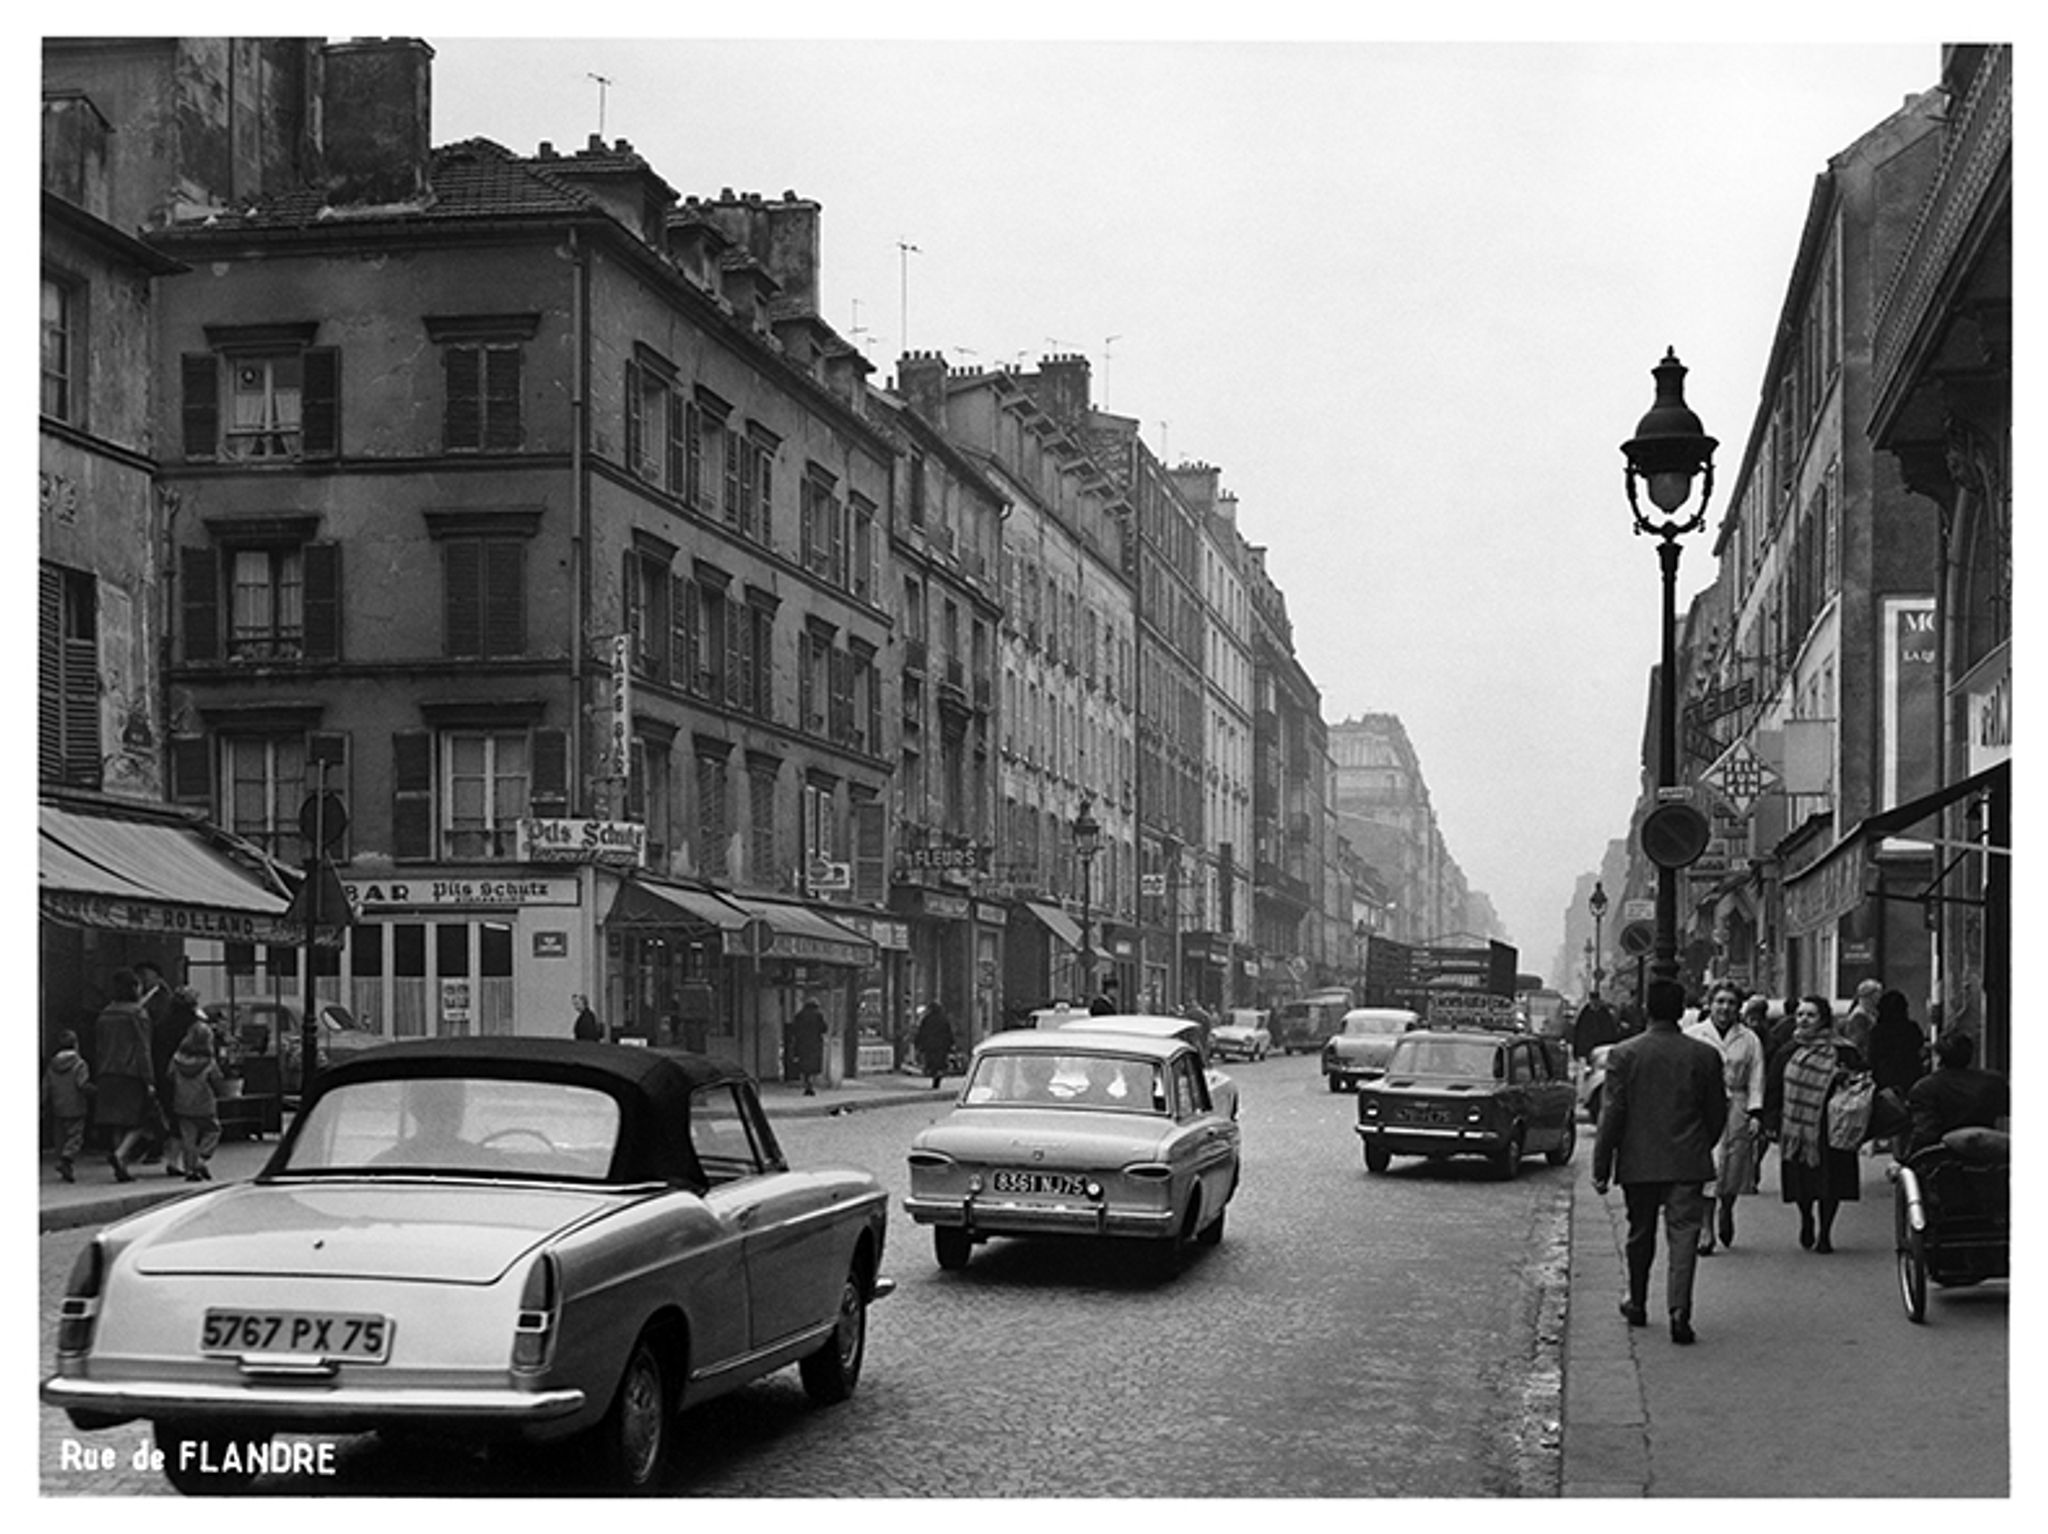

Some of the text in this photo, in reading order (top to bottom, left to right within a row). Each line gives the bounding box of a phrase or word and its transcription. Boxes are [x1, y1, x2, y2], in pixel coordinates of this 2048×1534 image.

[915, 850, 976, 867] FLEURS
[344, 881, 549, 902] BAR Pils Schutz
[164, 909, 256, 935] ROLLAND
[203, 1314, 385, 1353] 5767 PX 75
